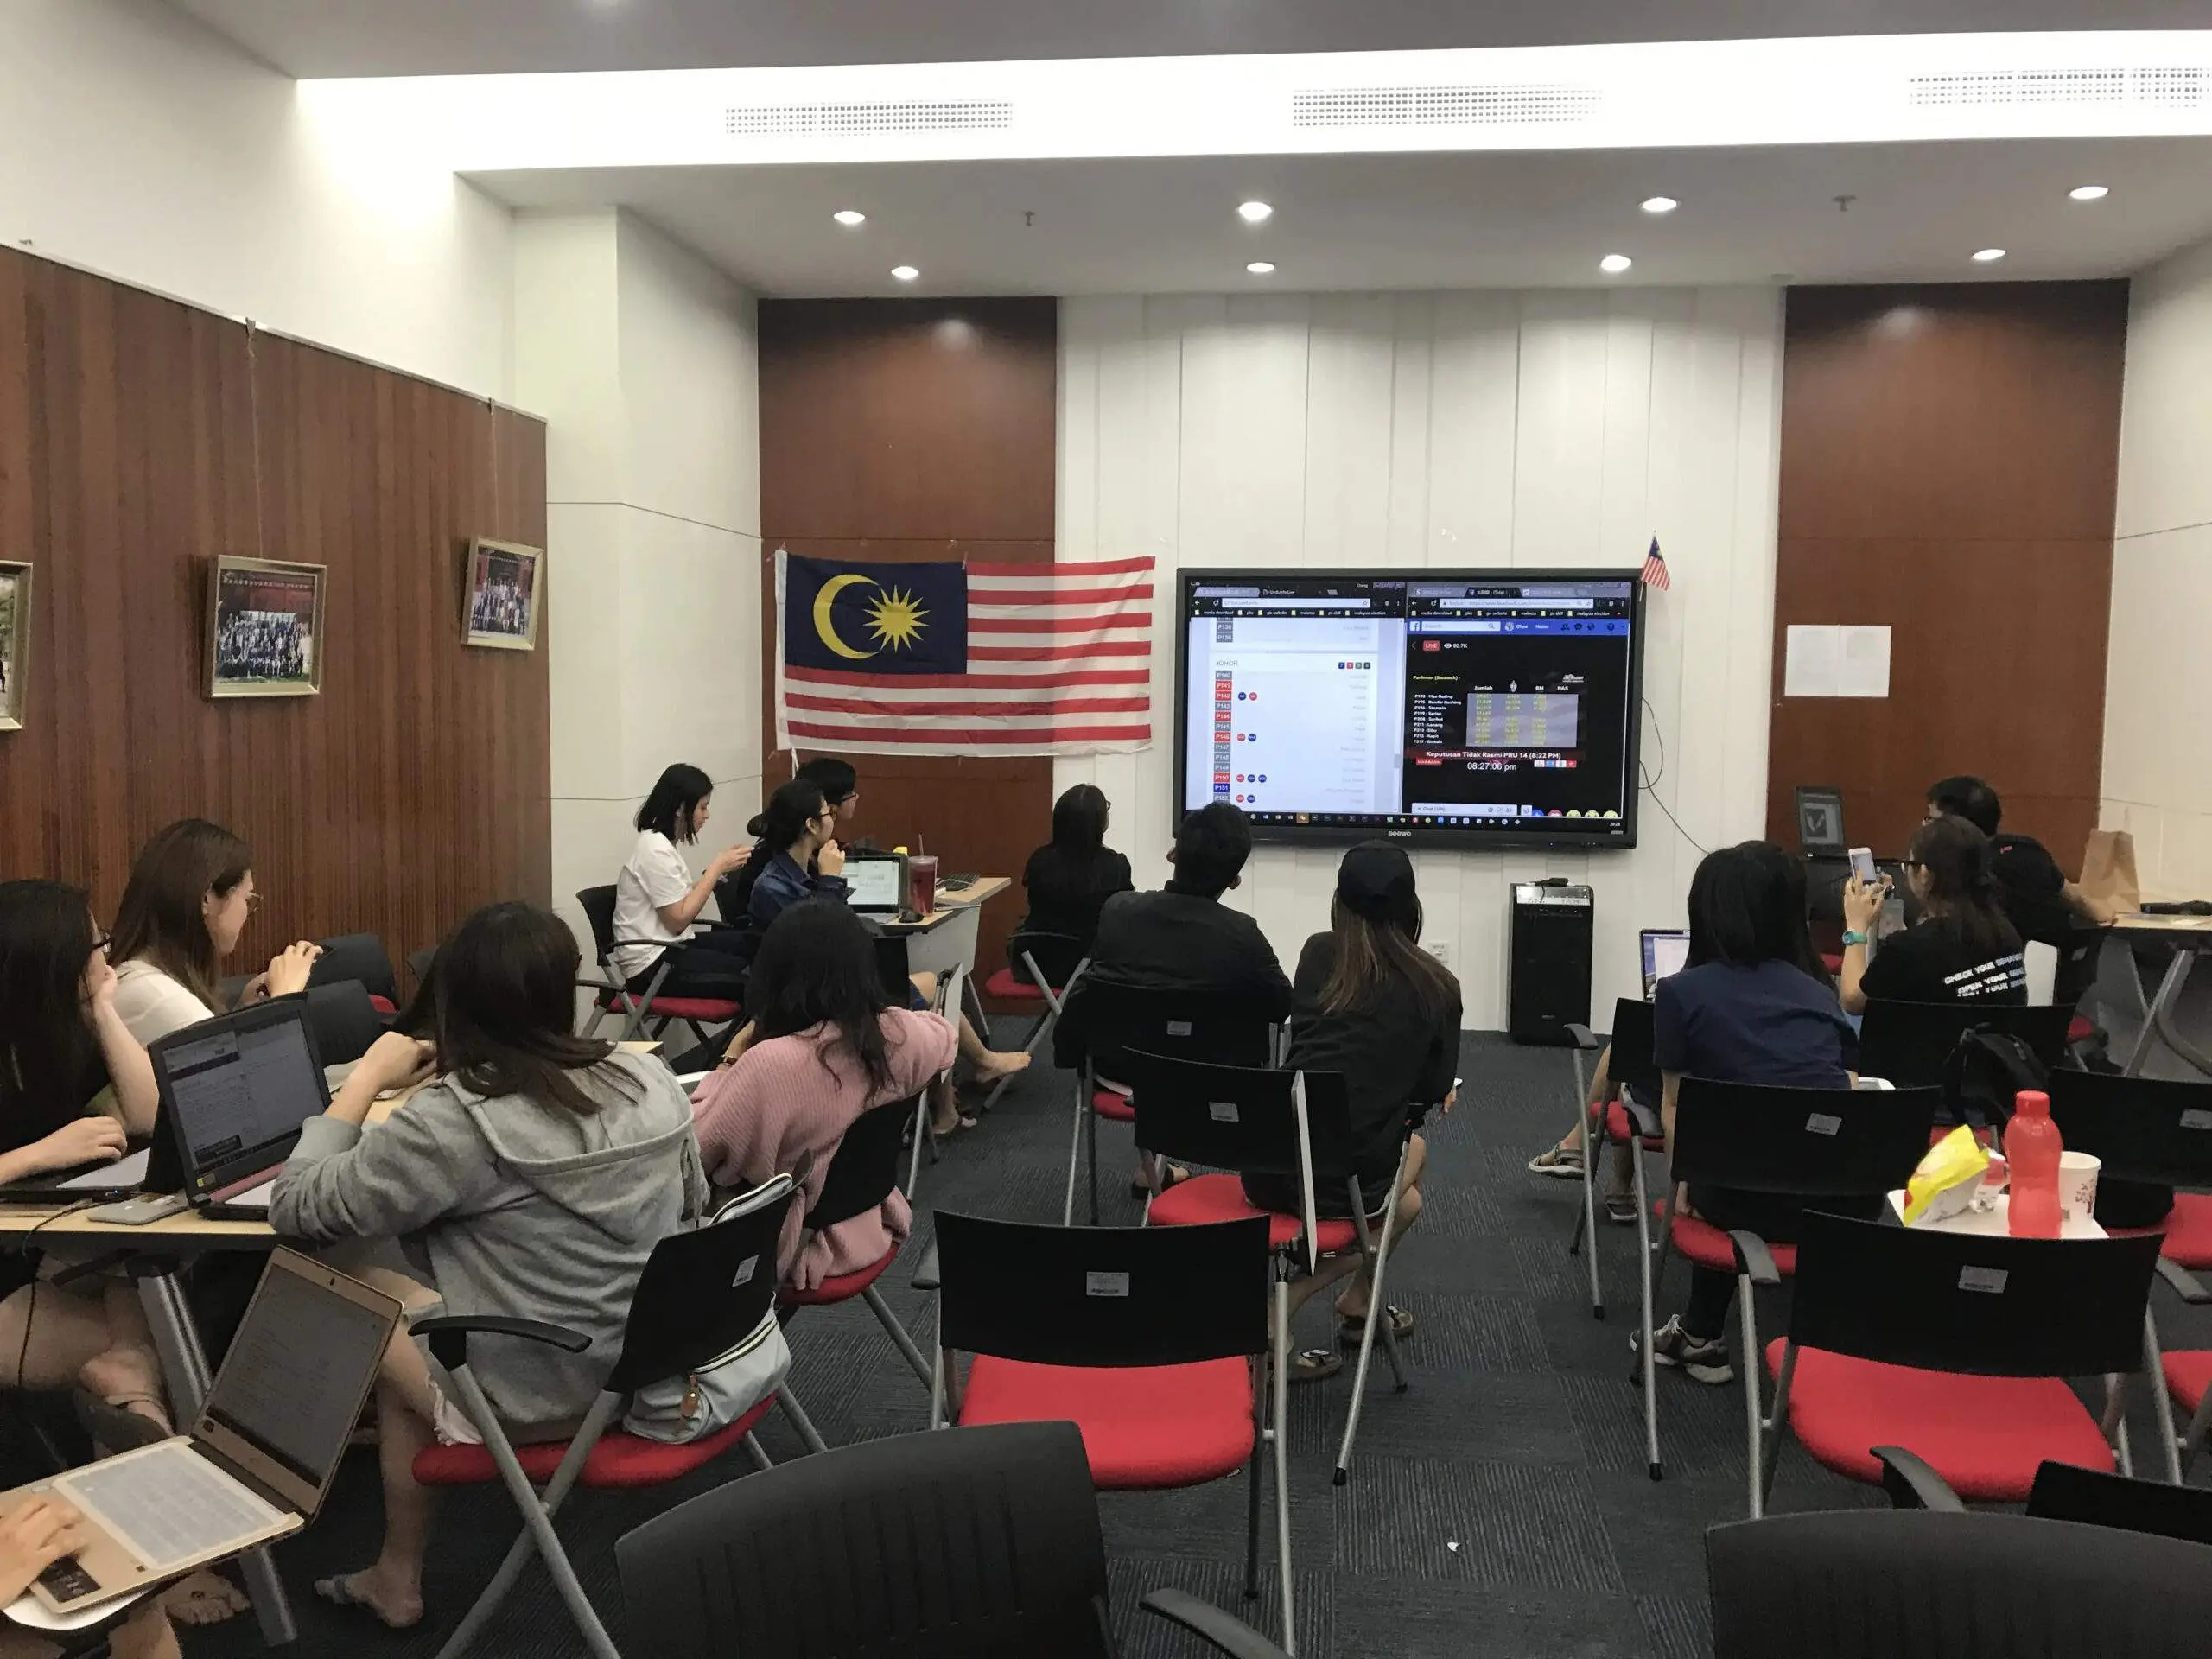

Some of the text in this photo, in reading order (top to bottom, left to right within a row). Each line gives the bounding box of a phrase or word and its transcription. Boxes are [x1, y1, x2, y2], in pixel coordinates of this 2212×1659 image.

[1944, 969, 1974, 985] CHECK
[1974, 961, 1996, 974] YOUR
[1984, 972, 2009, 984] YOUR
